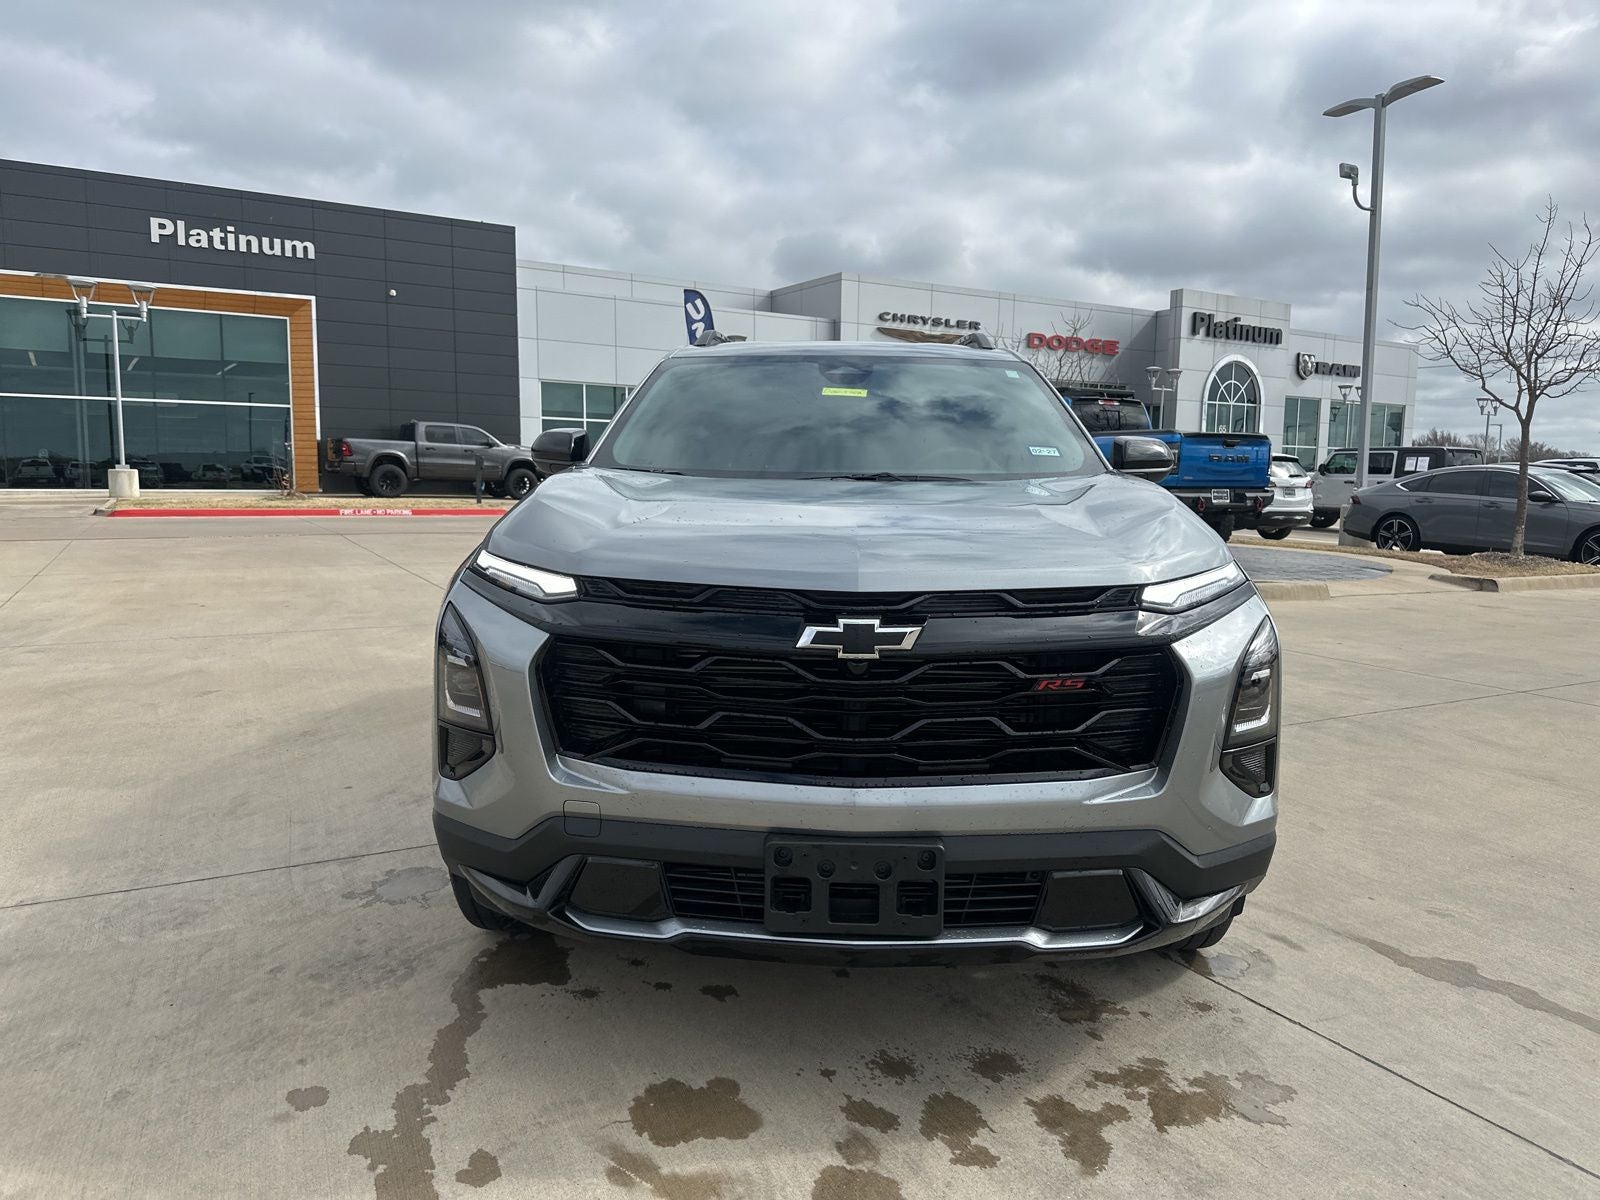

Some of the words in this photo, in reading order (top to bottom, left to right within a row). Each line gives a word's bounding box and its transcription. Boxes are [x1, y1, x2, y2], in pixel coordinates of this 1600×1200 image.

[150, 217, 315, 259] Platinum
[879, 312, 981, 330] CHRYSLER
[1192, 312, 1282, 345] Platinum
[1027, 332, 1120, 356] DODGE
[1316, 361, 1360, 378] RAM
[1209, 455, 1249, 464] RAM
[1036, 679, 1085, 690] RS
